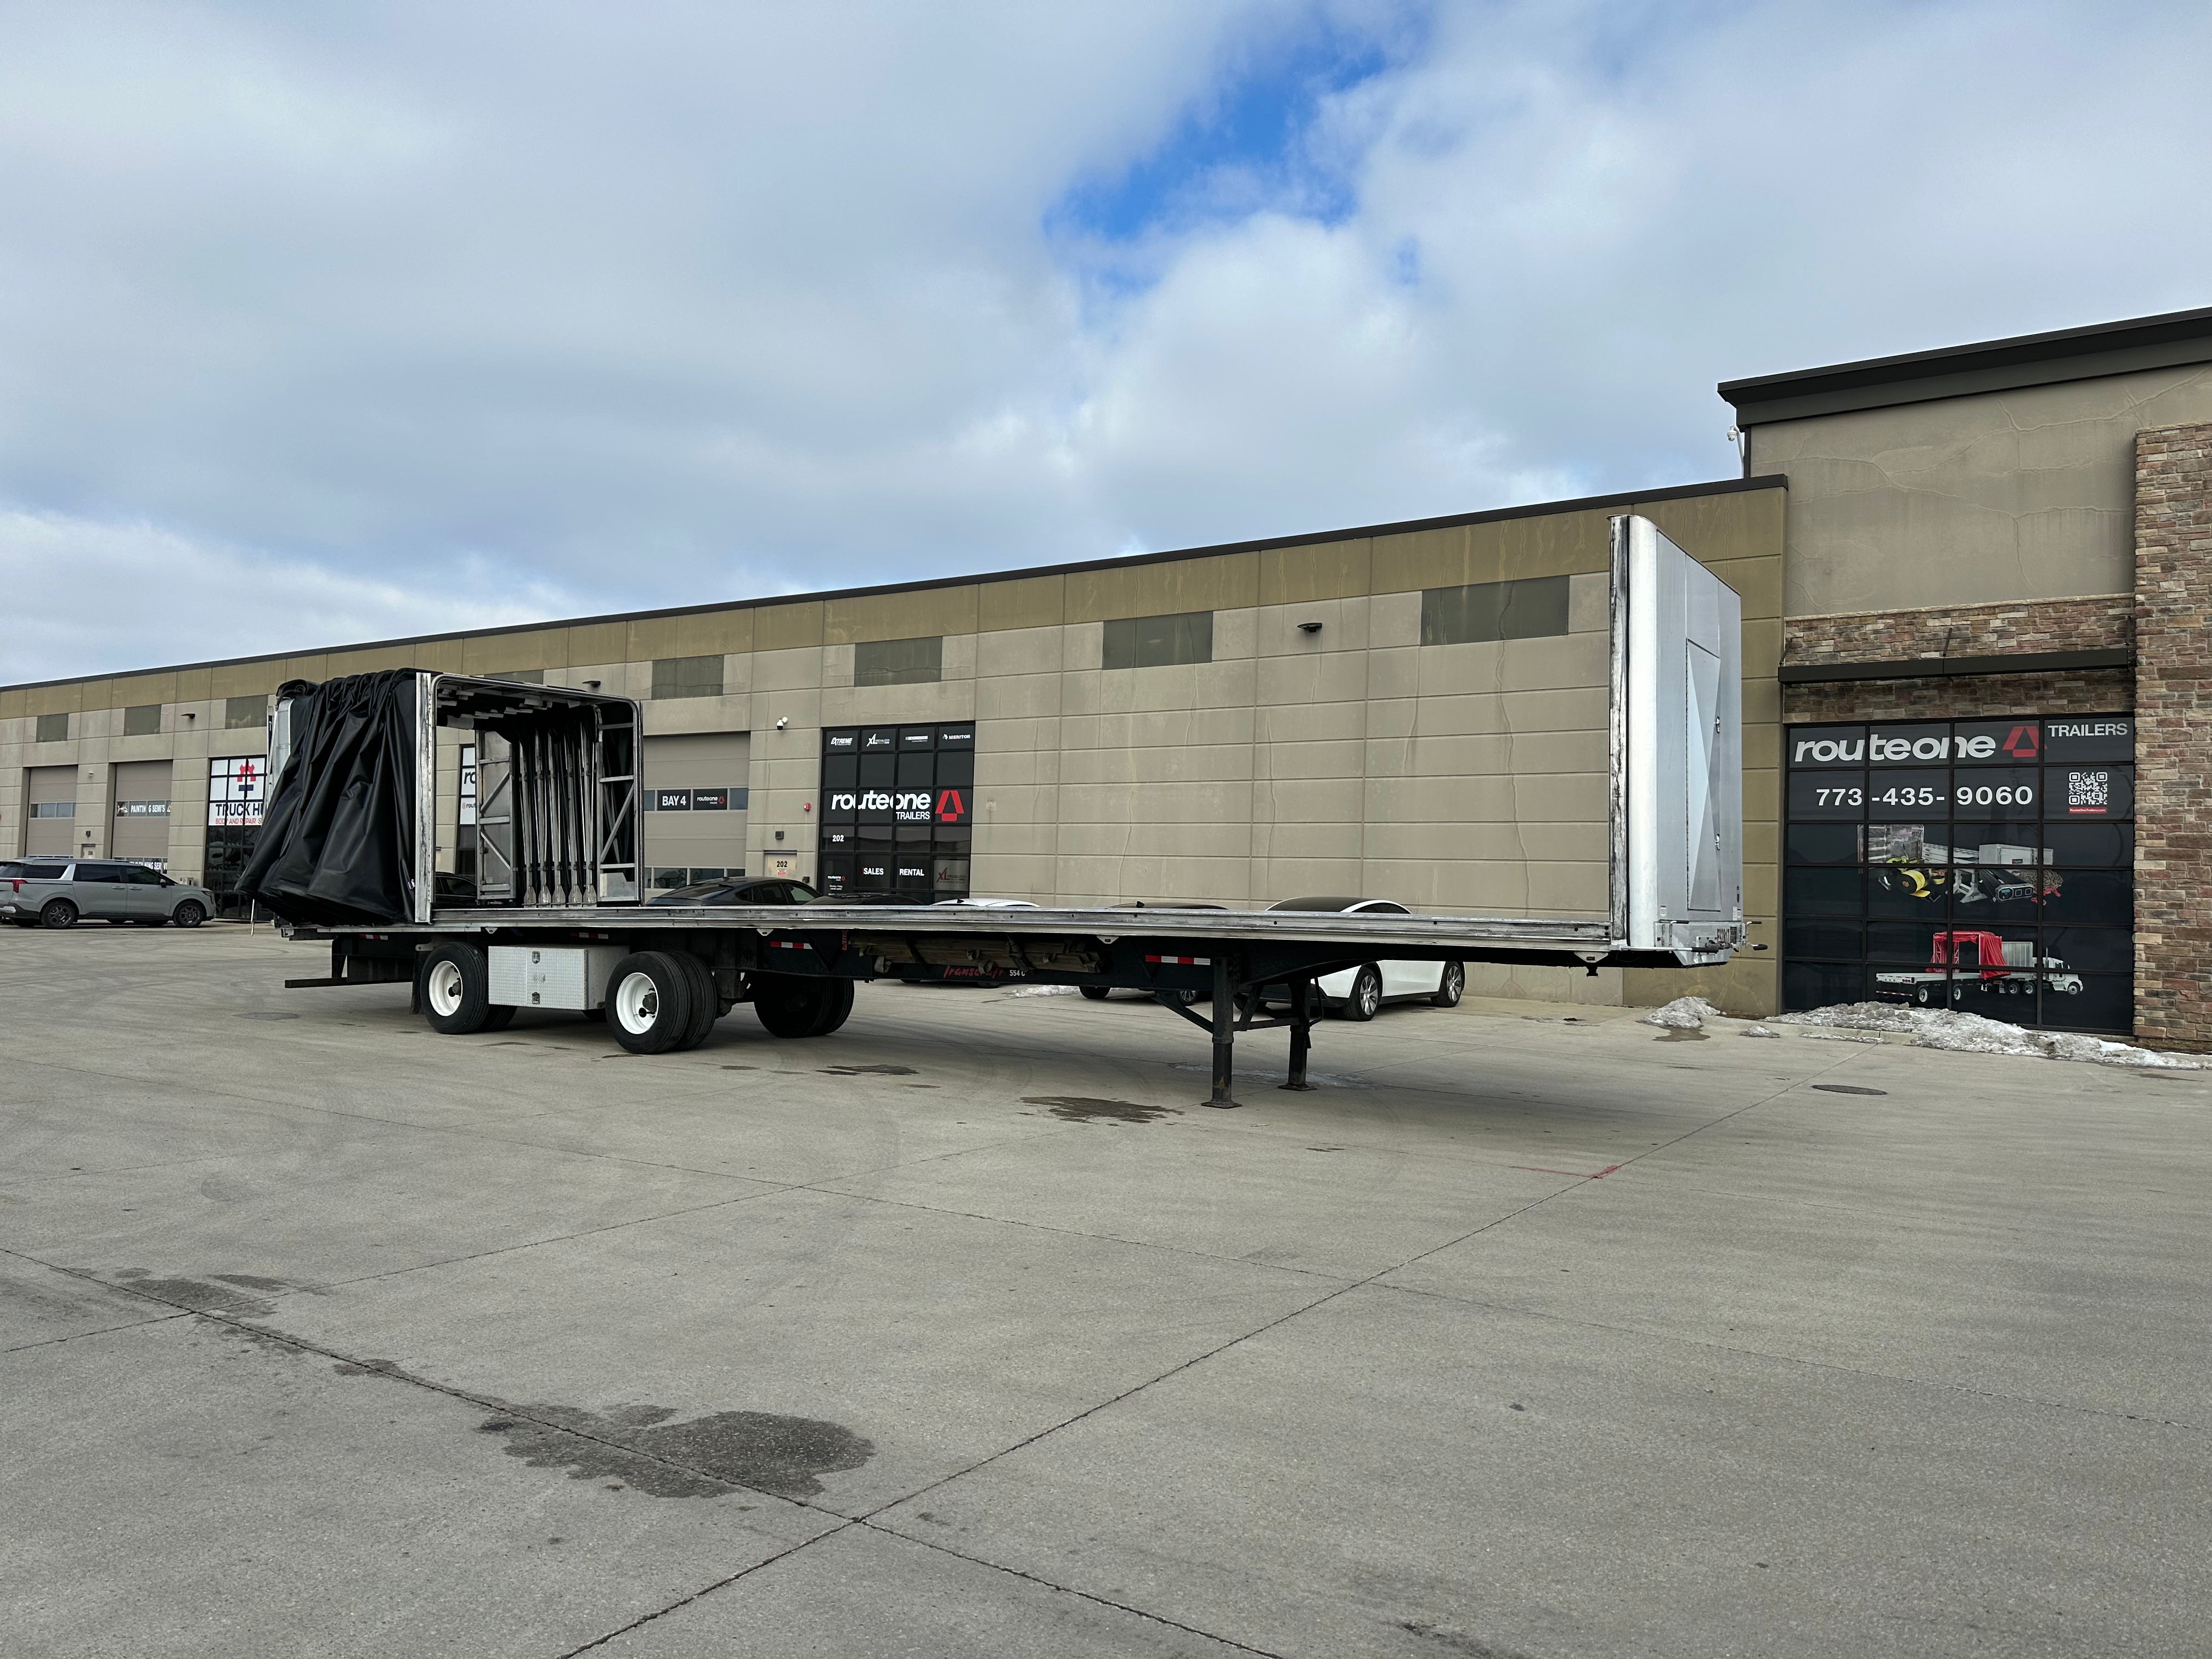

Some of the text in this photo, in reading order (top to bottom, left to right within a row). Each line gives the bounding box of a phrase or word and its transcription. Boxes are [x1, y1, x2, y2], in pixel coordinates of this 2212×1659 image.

[2047, 723, 2128, 737] TRAILERS
[1795, 734, 1996, 762] routeone
[662, 795, 686, 806] BAY 4
[831, 790, 931, 810] routeone
[216, 803, 250, 816] TRUCK
[896, 811, 930, 820] TRAILERS
[944, 965, 1004, 979] Transcaft
